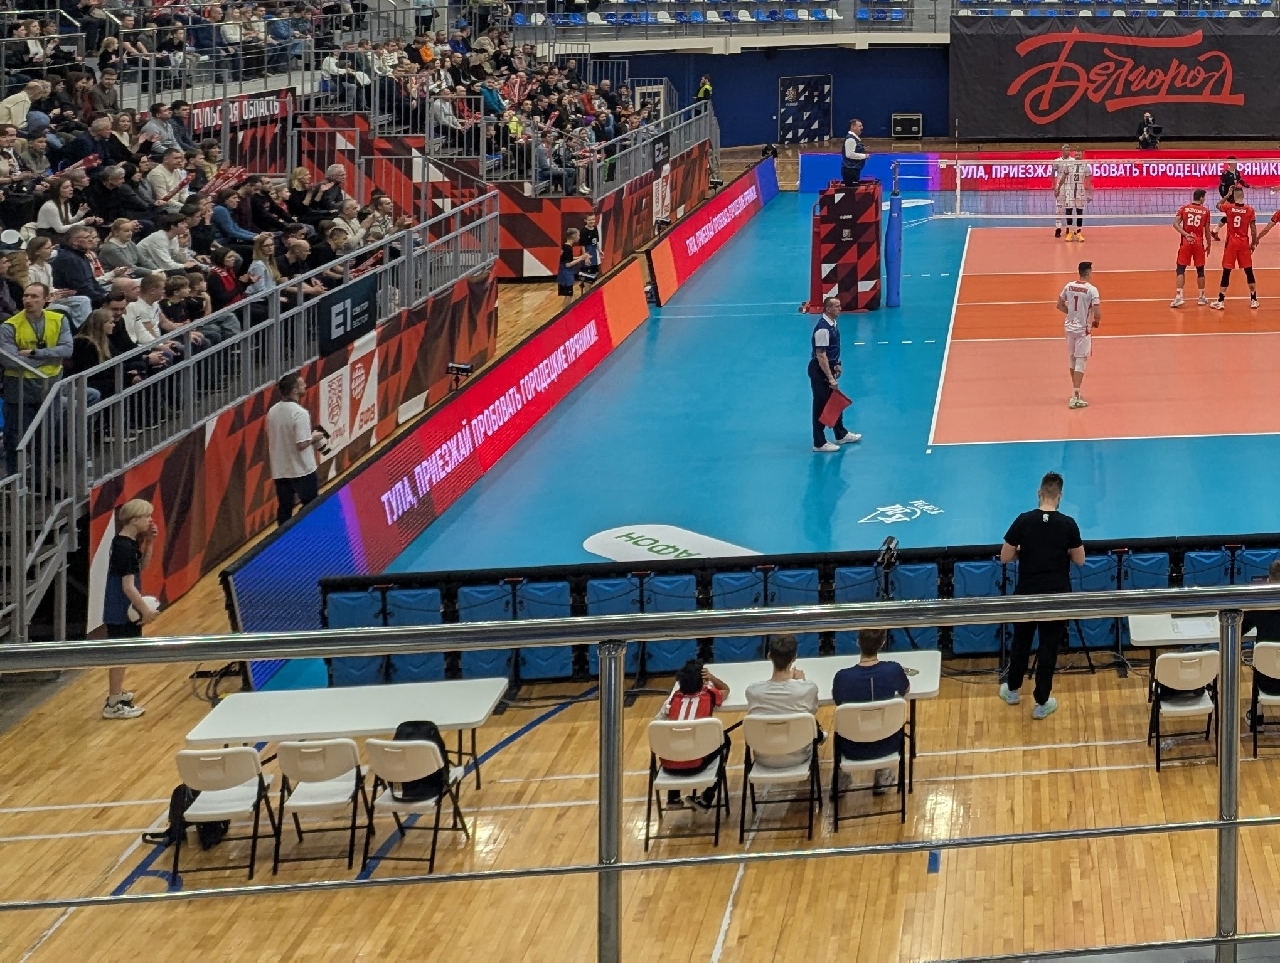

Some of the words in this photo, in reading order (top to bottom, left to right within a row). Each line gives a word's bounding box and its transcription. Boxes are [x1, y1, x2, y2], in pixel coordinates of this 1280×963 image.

[1006, 27, 1245, 125] Белгород
[192, 101, 239, 130] ТУЛЬСАЯ
[242, 96, 280, 120] ОБЛАСТЬ
[992, 164, 1058, 179] ПРИЕЗЖА
[1143, 163, 1225, 178] ГОРОДЕЦКИЕ
[1233, 215, 1242, 228] 9
[330, 298, 351, 340] E1
[380, 476, 418, 527] ТУЛА,
[413, 418, 473, 499] ПРИЕЗЖАЙ
[471, 385, 522, 448] ПРОБОВАТЬ
[519, 344, 568, 405] ГОРОДЕЦКИЕ
[614, 532, 702, 558] АФОН
[677, 696, 700, 721] 11
